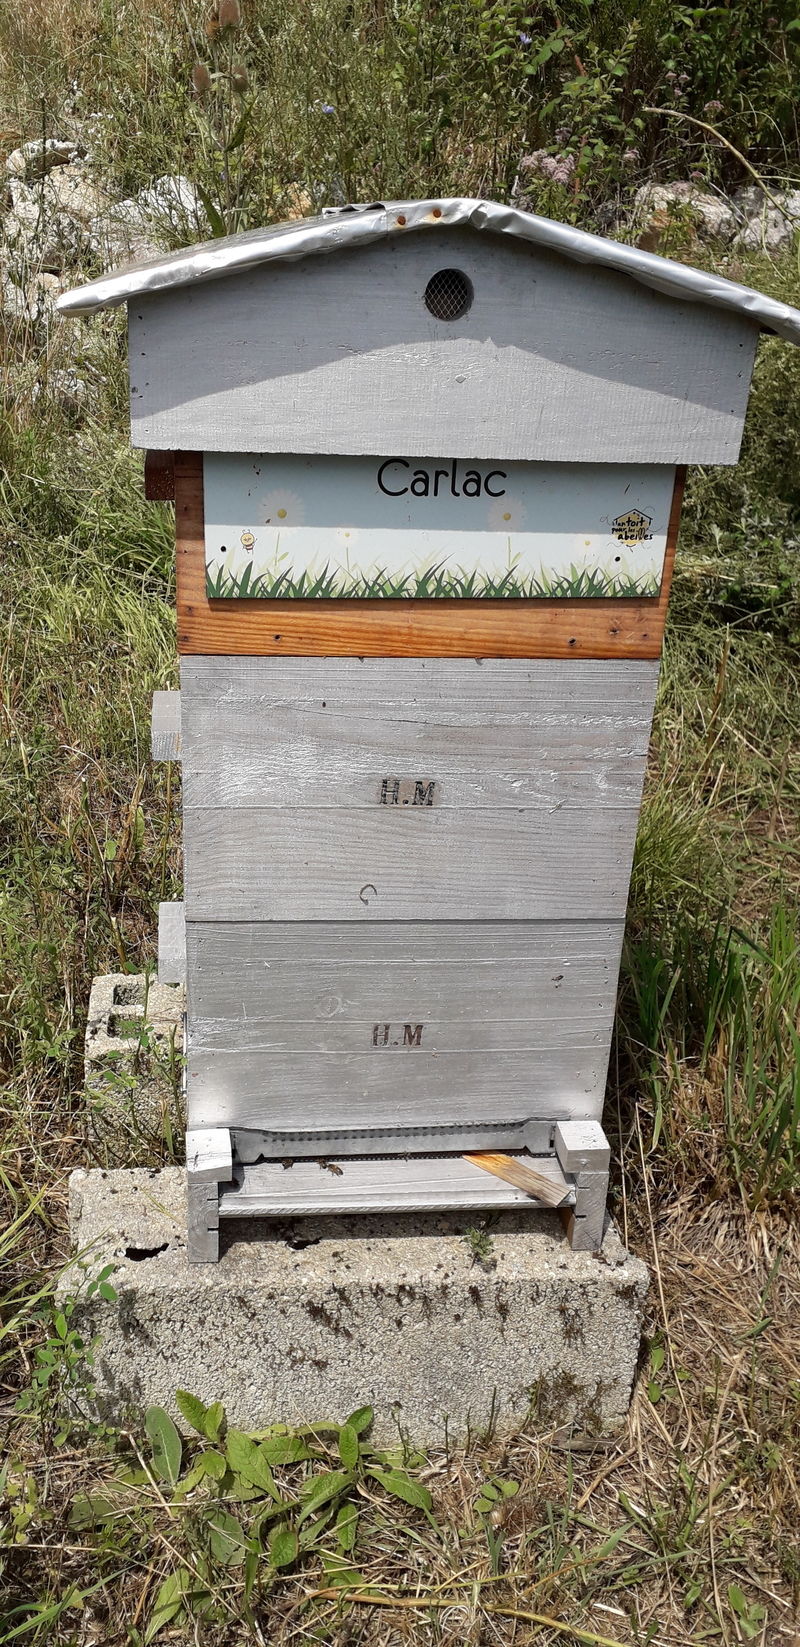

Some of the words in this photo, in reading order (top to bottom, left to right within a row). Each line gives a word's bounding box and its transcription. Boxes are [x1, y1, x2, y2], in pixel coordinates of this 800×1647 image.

[377, 458, 507, 497] Carlac
[626, 516, 646, 527] toit
[379, 778, 436, 806] H.M
[371, 1024, 424, 1047] H.M
